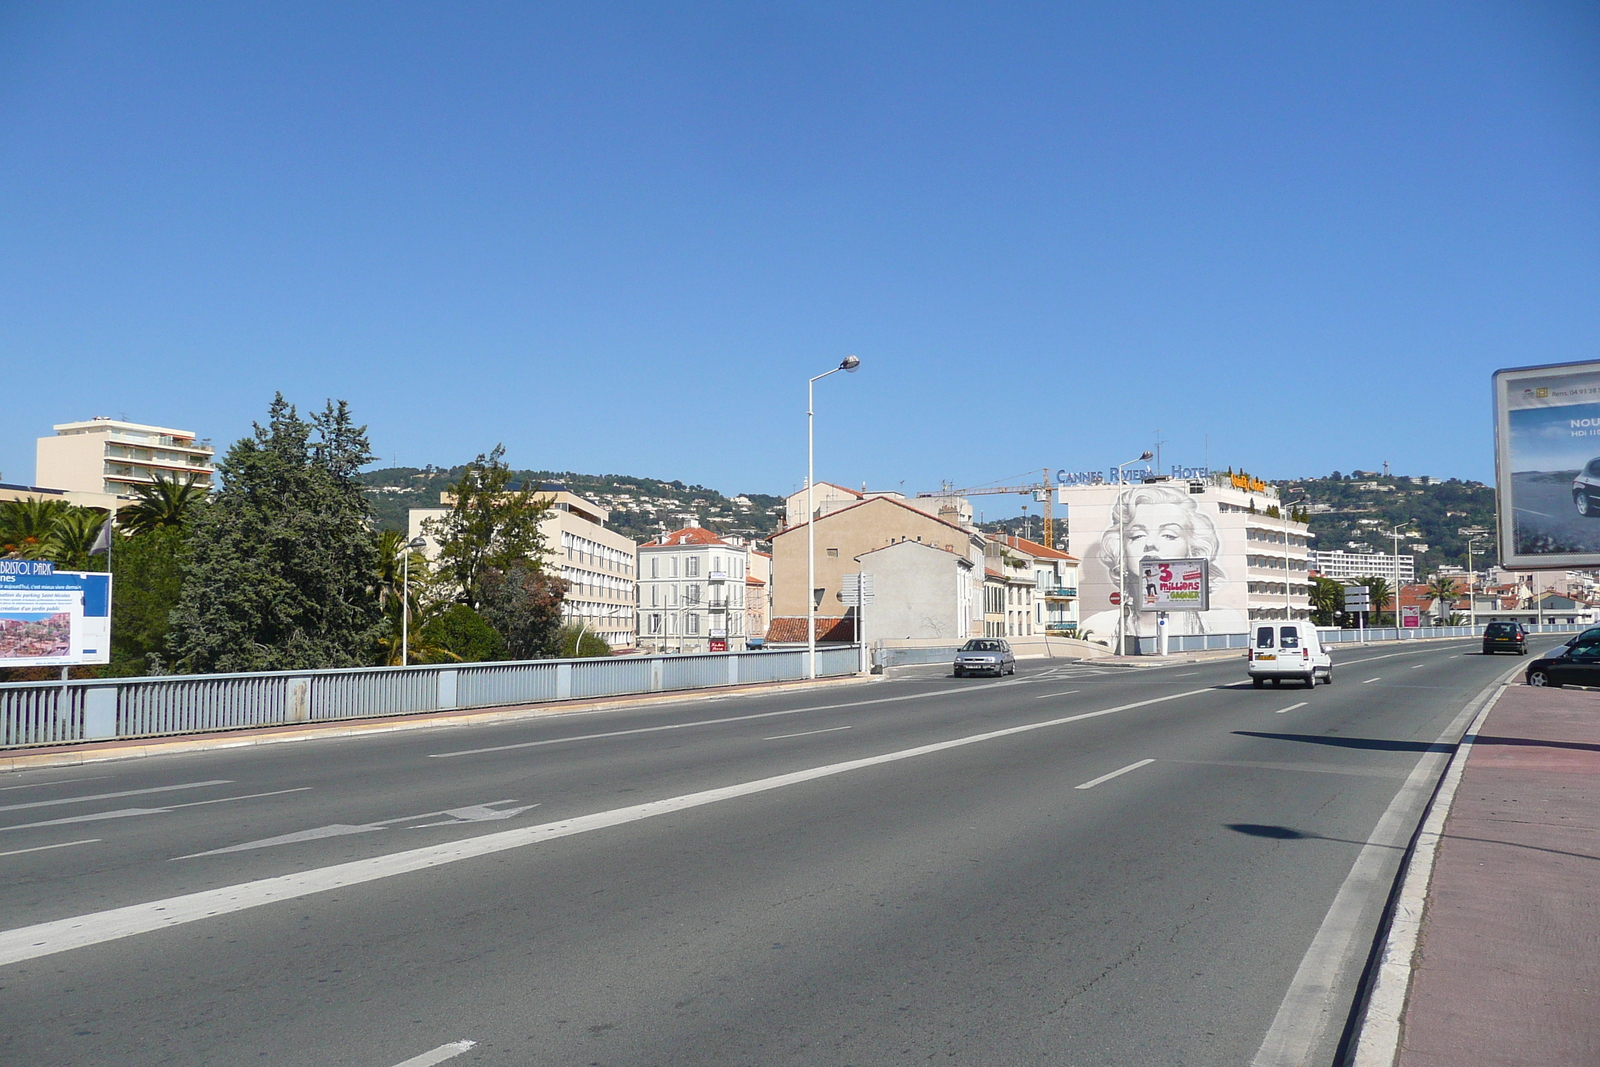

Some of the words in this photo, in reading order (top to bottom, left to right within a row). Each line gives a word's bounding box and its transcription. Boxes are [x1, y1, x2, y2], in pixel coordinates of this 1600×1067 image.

[1056, 469, 1103, 484] CANNES
[1109, 467, 1156, 481] RVIERA
[1171, 465, 1212, 479] HOTEL
[0, 561, 31, 576] BRISTOL
[33, 562, 52, 576] PARK
[1158, 564, 1173, 582] 3
[22, 592, 41, 600] parking
